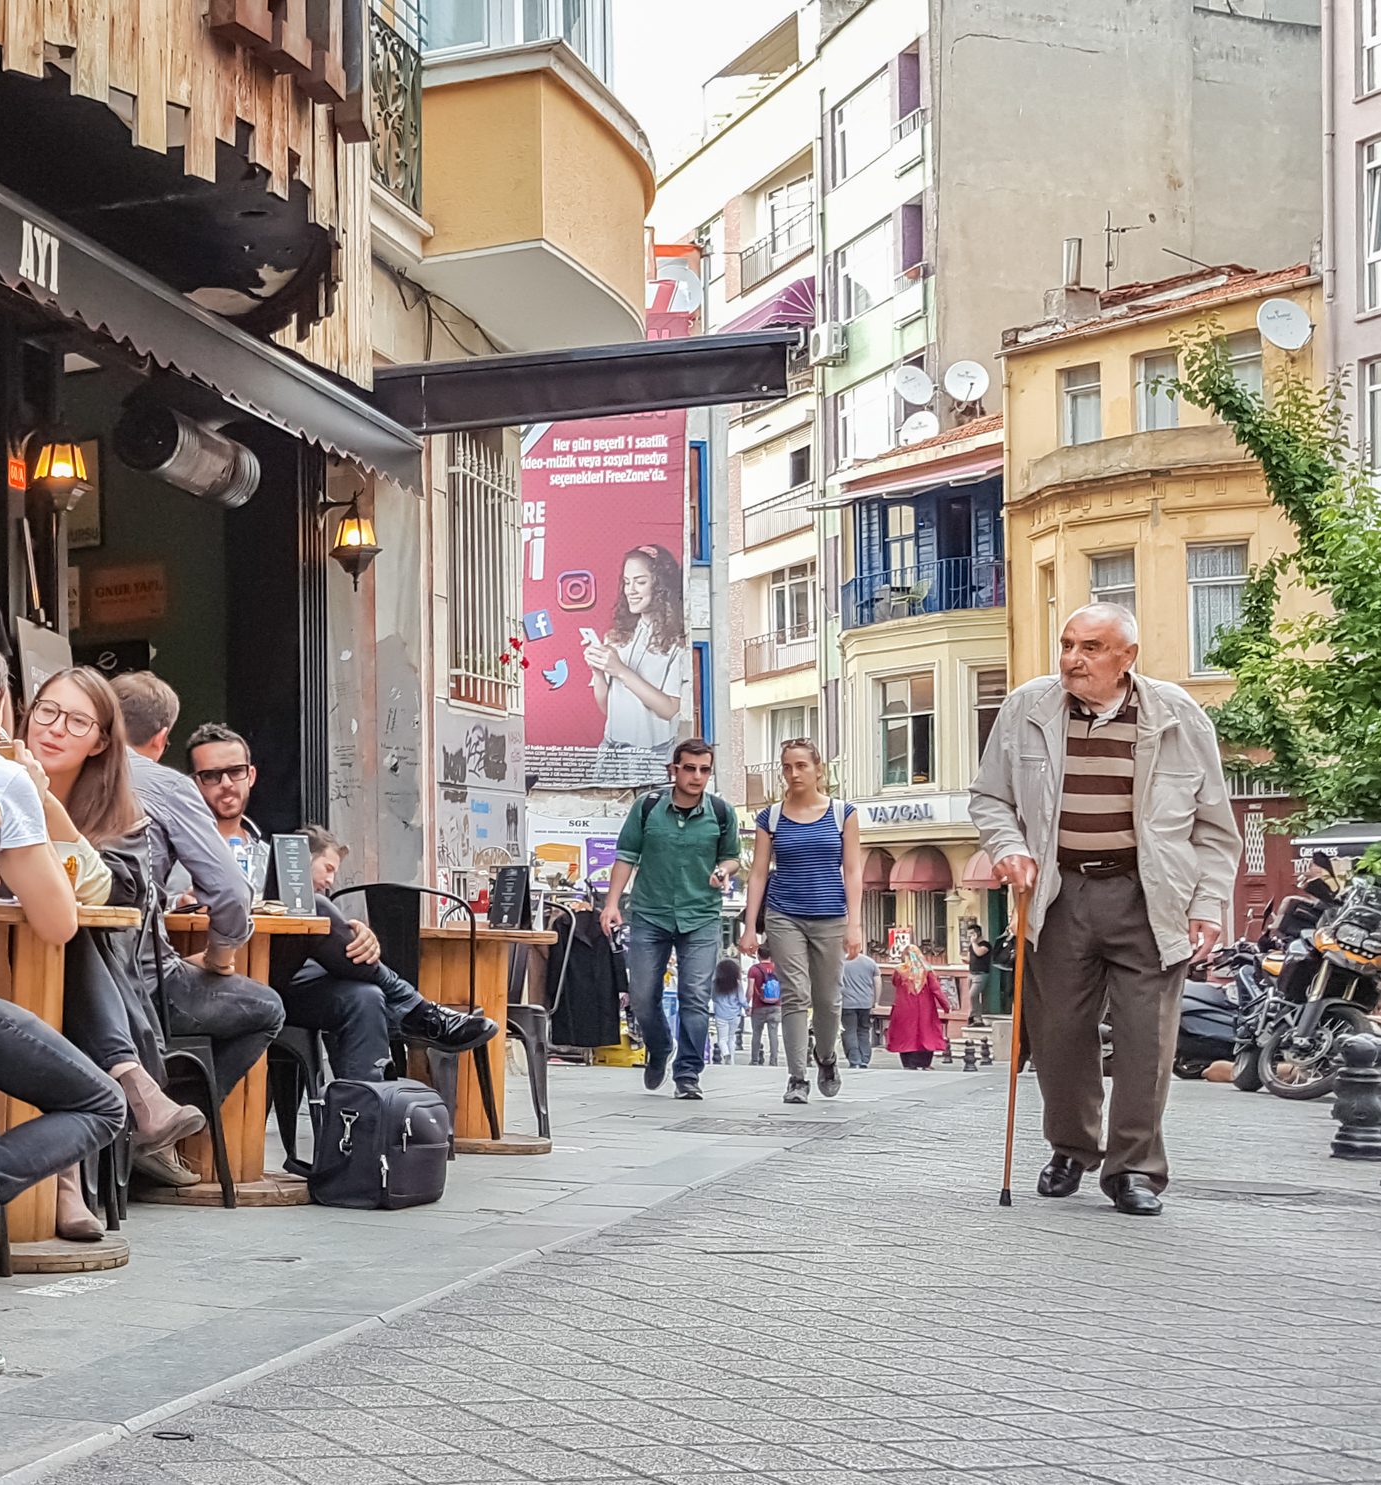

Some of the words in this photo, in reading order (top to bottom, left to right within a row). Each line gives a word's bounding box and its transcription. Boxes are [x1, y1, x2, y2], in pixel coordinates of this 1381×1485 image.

[19, 220, 59, 295] AYI
[553, 438, 570, 451] Her
[572, 437, 591, 452] gün
[593, 436, 624, 452] geçerli
[627, 436, 632, 448] 1
[635, 435, 668, 448] saatlik
[521, 455, 576, 469] ideo-müzik
[578, 456, 601, 468] veya
[603, 454, 632, 468] sosyal
[634, 452, 667, 466] medya
[550, 469, 604, 487] seçenekleri
[867, 803, 933, 823] VAZGAL
[568, 820, 590, 828] SGK
